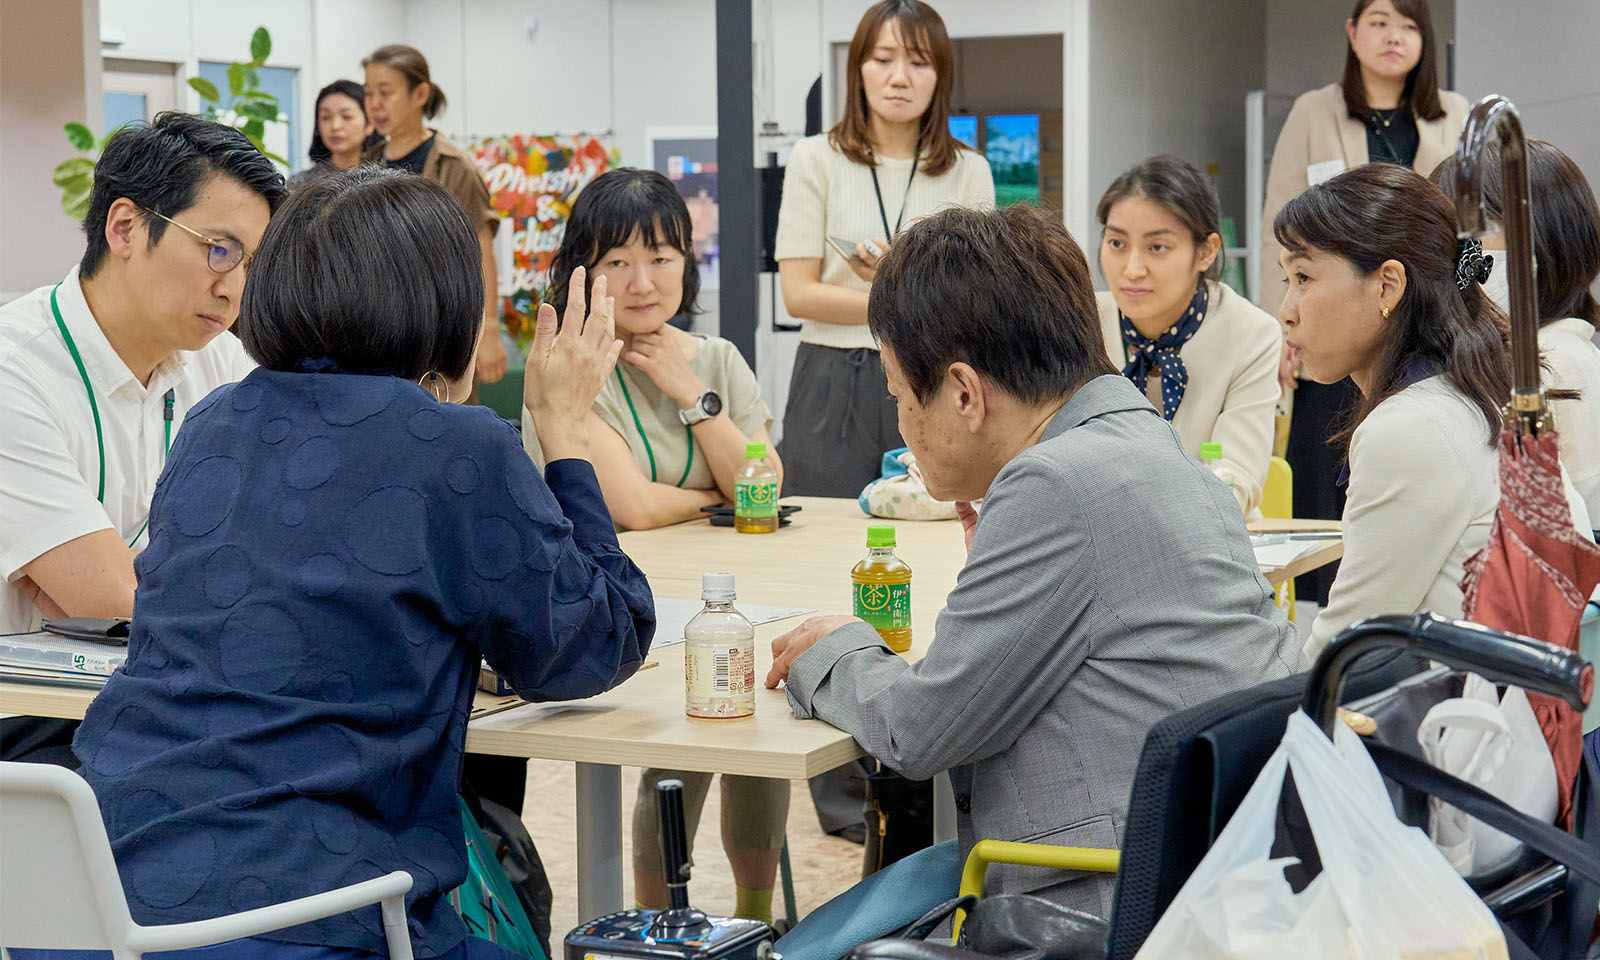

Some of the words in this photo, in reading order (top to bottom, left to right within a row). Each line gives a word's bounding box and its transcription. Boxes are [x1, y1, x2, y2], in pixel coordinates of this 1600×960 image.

[864, 584, 886, 606] 茶
[892, 589, 903, 627] 伊右衛門
[74, 655, 86, 671] A5
